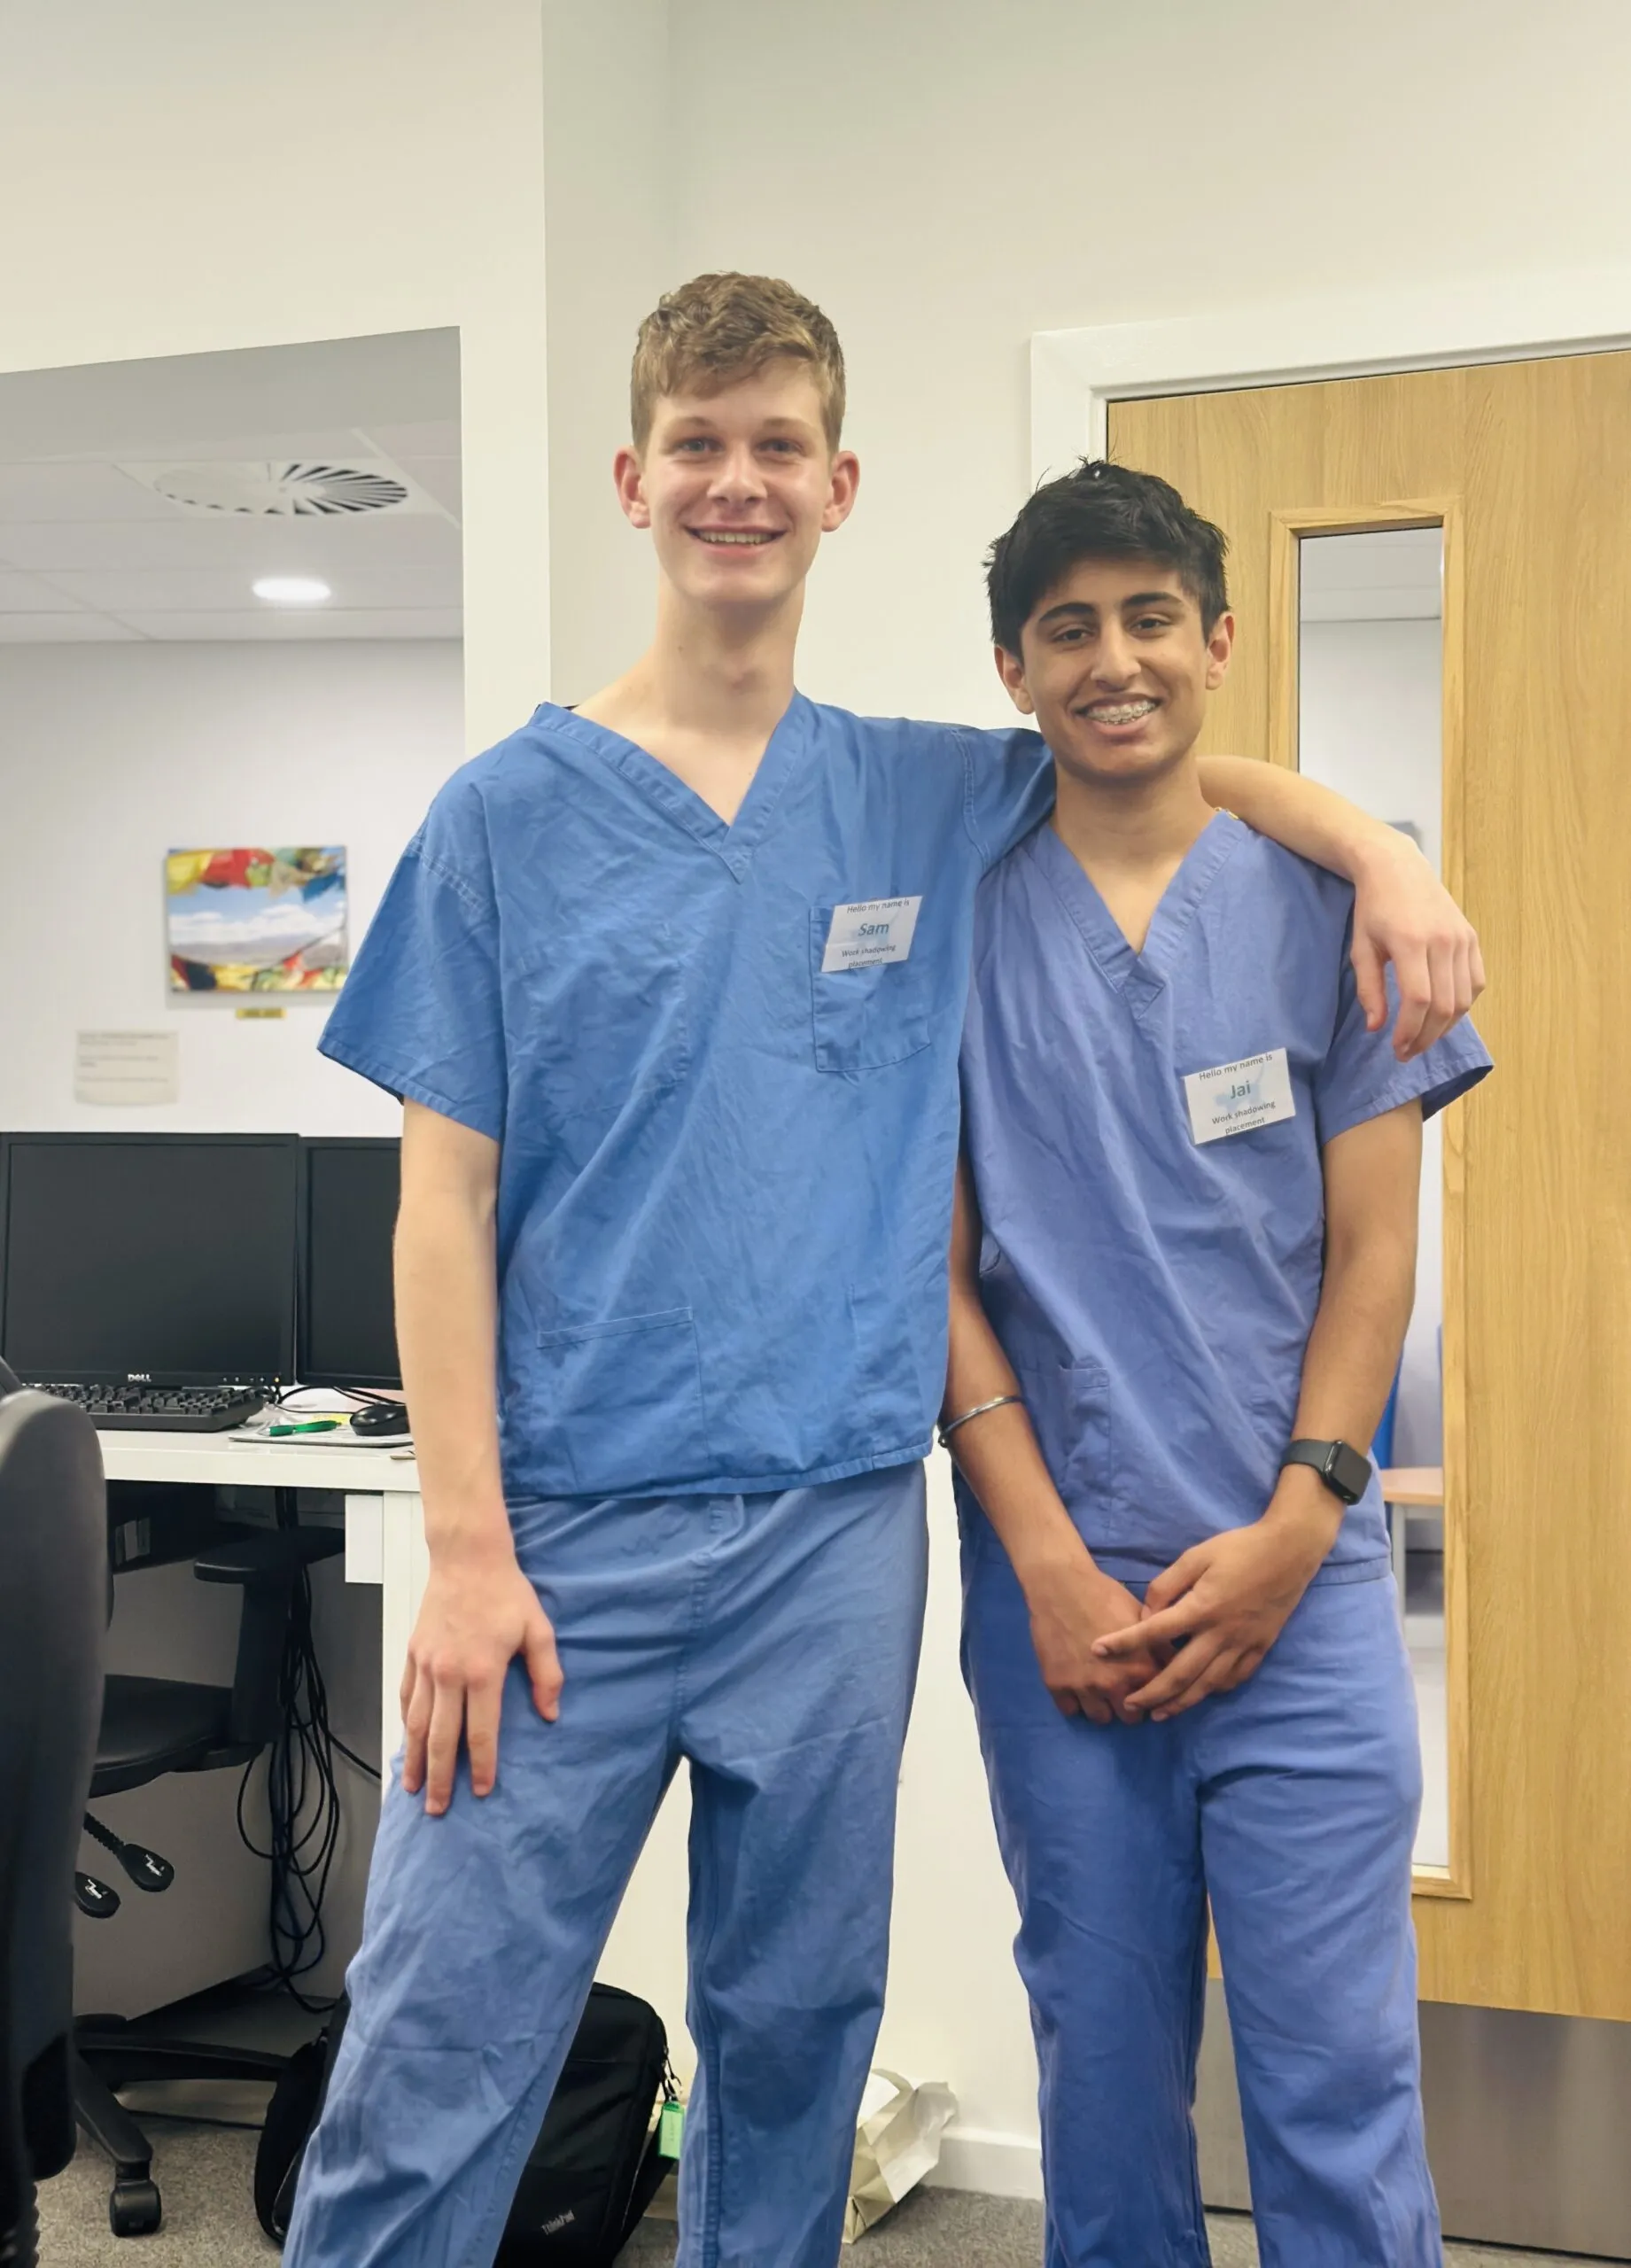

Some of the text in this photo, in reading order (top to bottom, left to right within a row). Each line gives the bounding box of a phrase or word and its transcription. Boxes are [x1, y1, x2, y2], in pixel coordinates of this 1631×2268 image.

[847, 897, 910, 913] Hello my name is
[858, 923, 889, 936] Sam
[842, 944, 897, 957] Work shadowing
[848, 958, 883, 968] placement
[1199, 1052, 1272, 1081] Hello my name is
[1230, 1080, 1251, 1099] Jai
[1212, 1101, 1276, 1124] Work shadowing
[1224, 1117, 1265, 1135] placement
[128, 1373, 151, 1382] DELL
